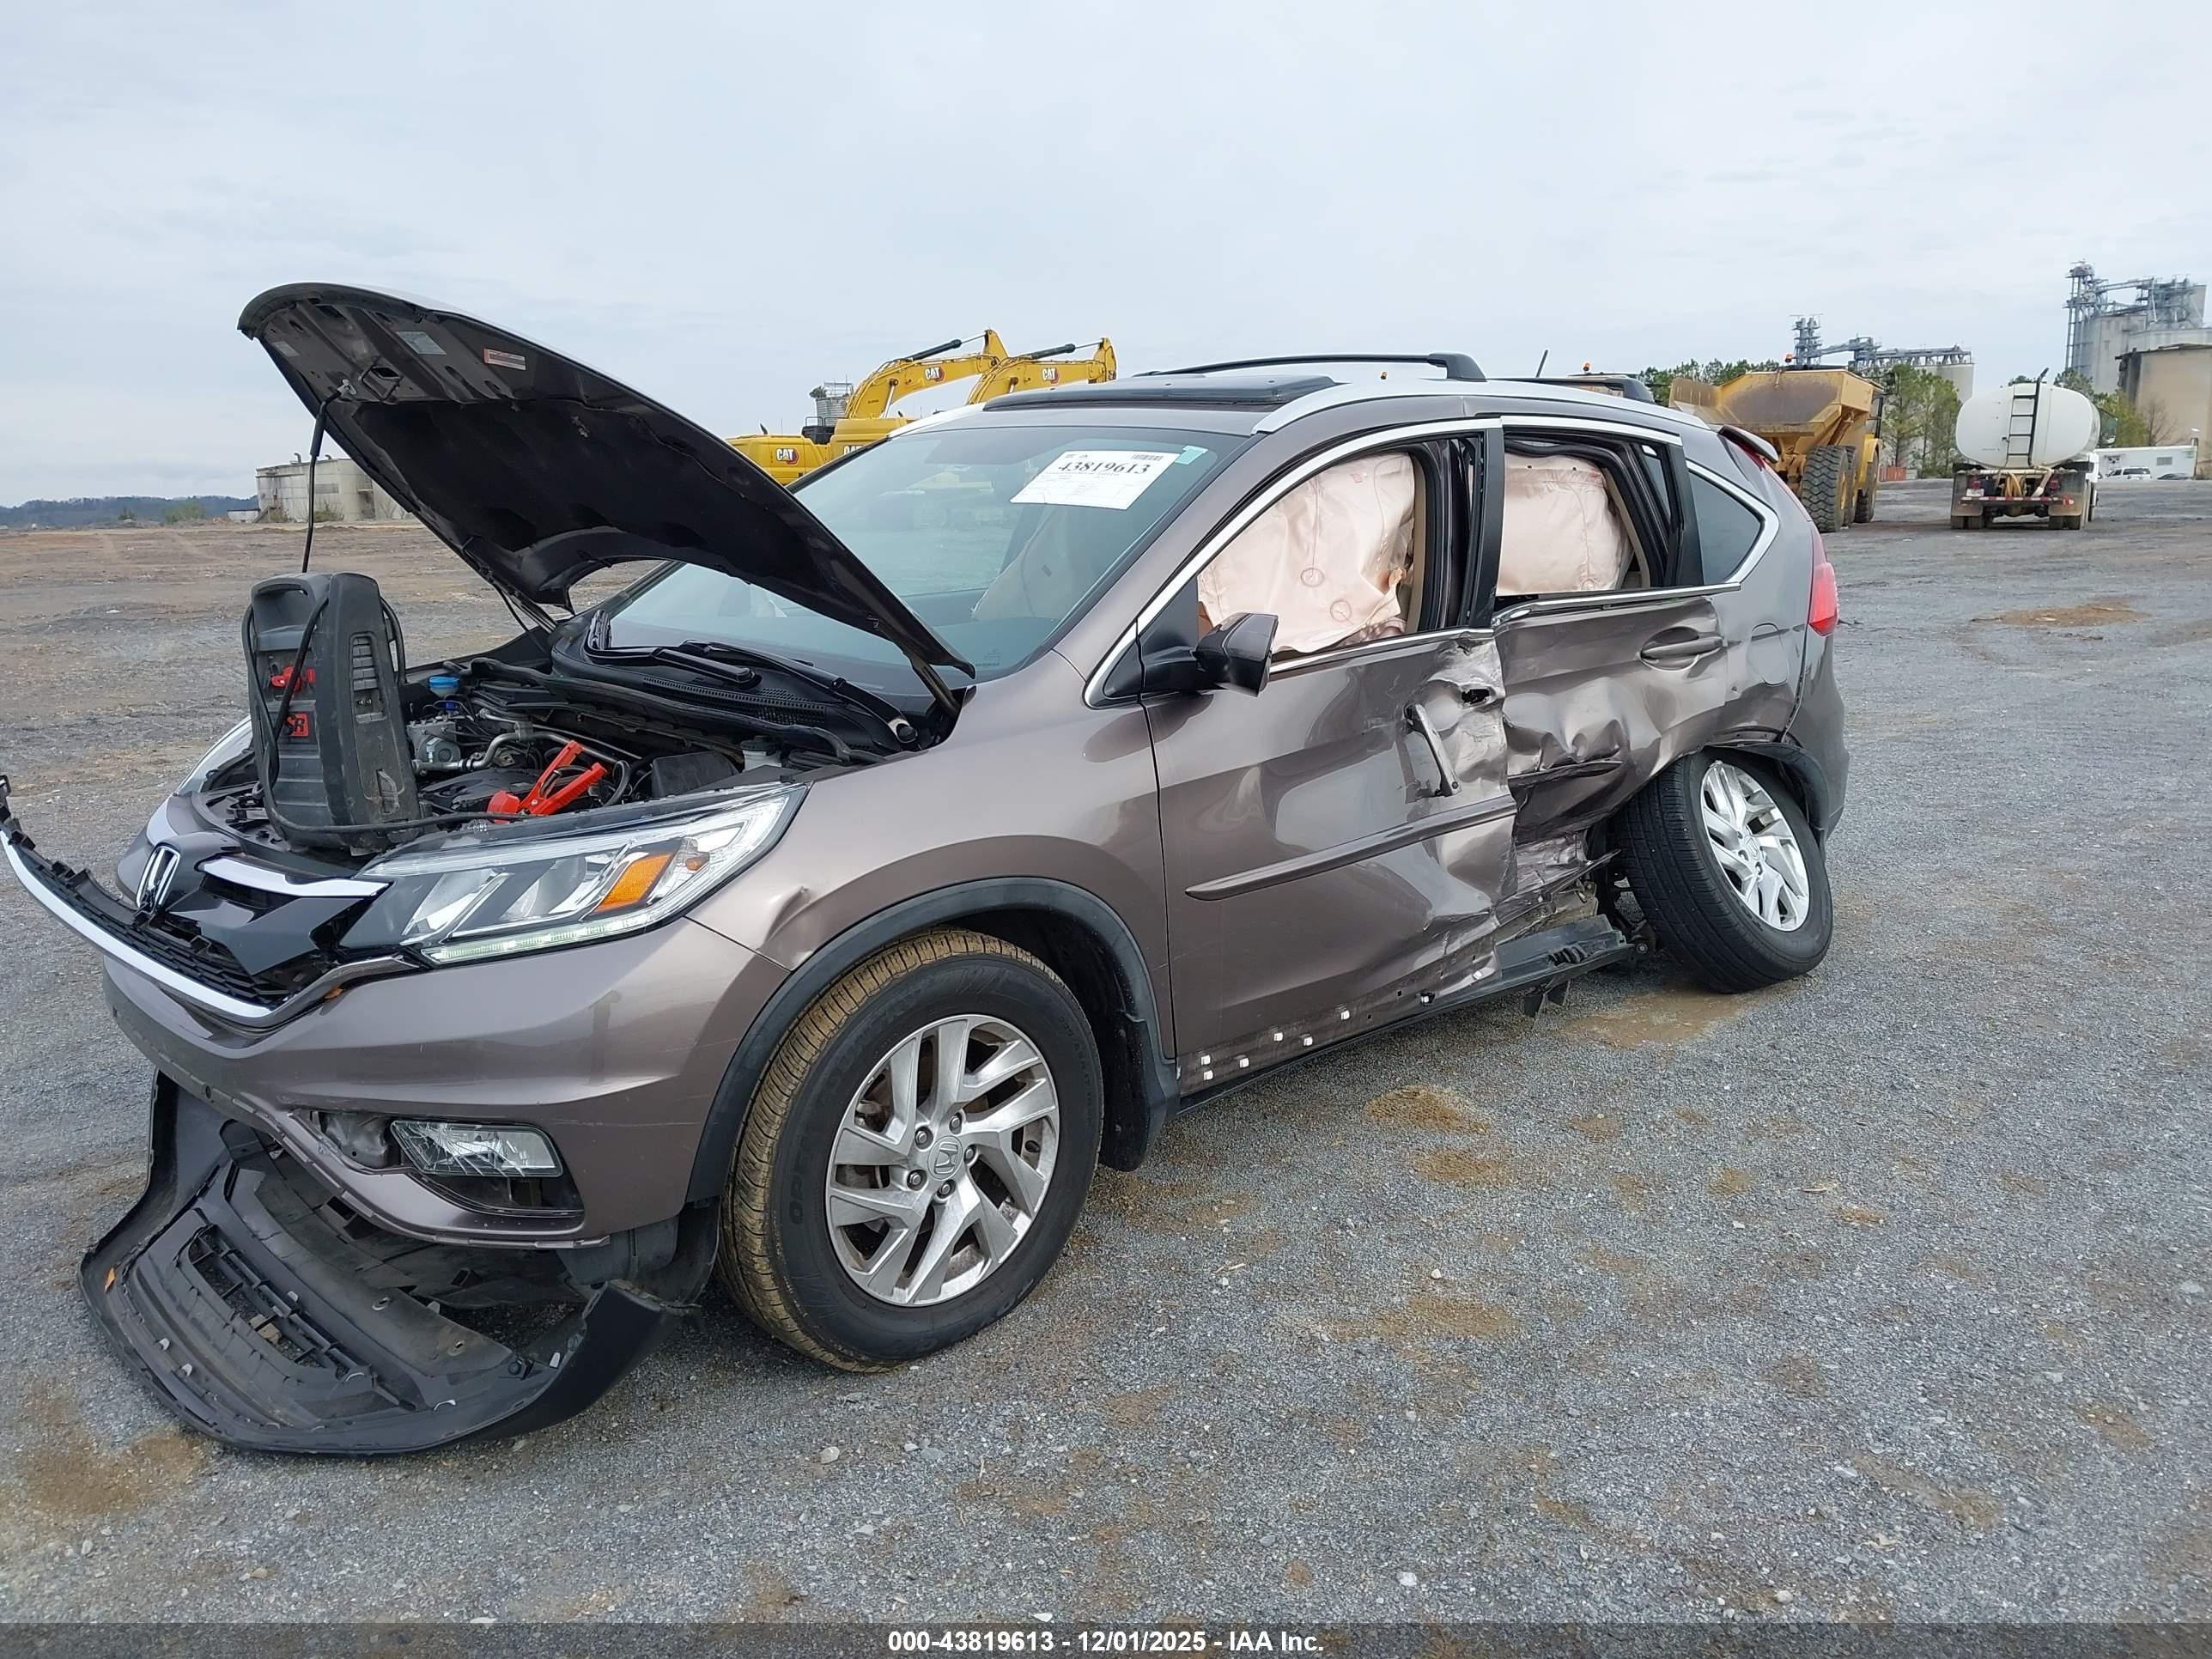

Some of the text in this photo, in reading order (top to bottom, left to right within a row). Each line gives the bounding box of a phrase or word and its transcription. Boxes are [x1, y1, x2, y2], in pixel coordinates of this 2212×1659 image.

[925, 367, 940, 380] CAT
[1042, 367, 1056, 381] CAT
[775, 447, 794, 462] CAT
[1058, 461, 1152, 474] 43819613
